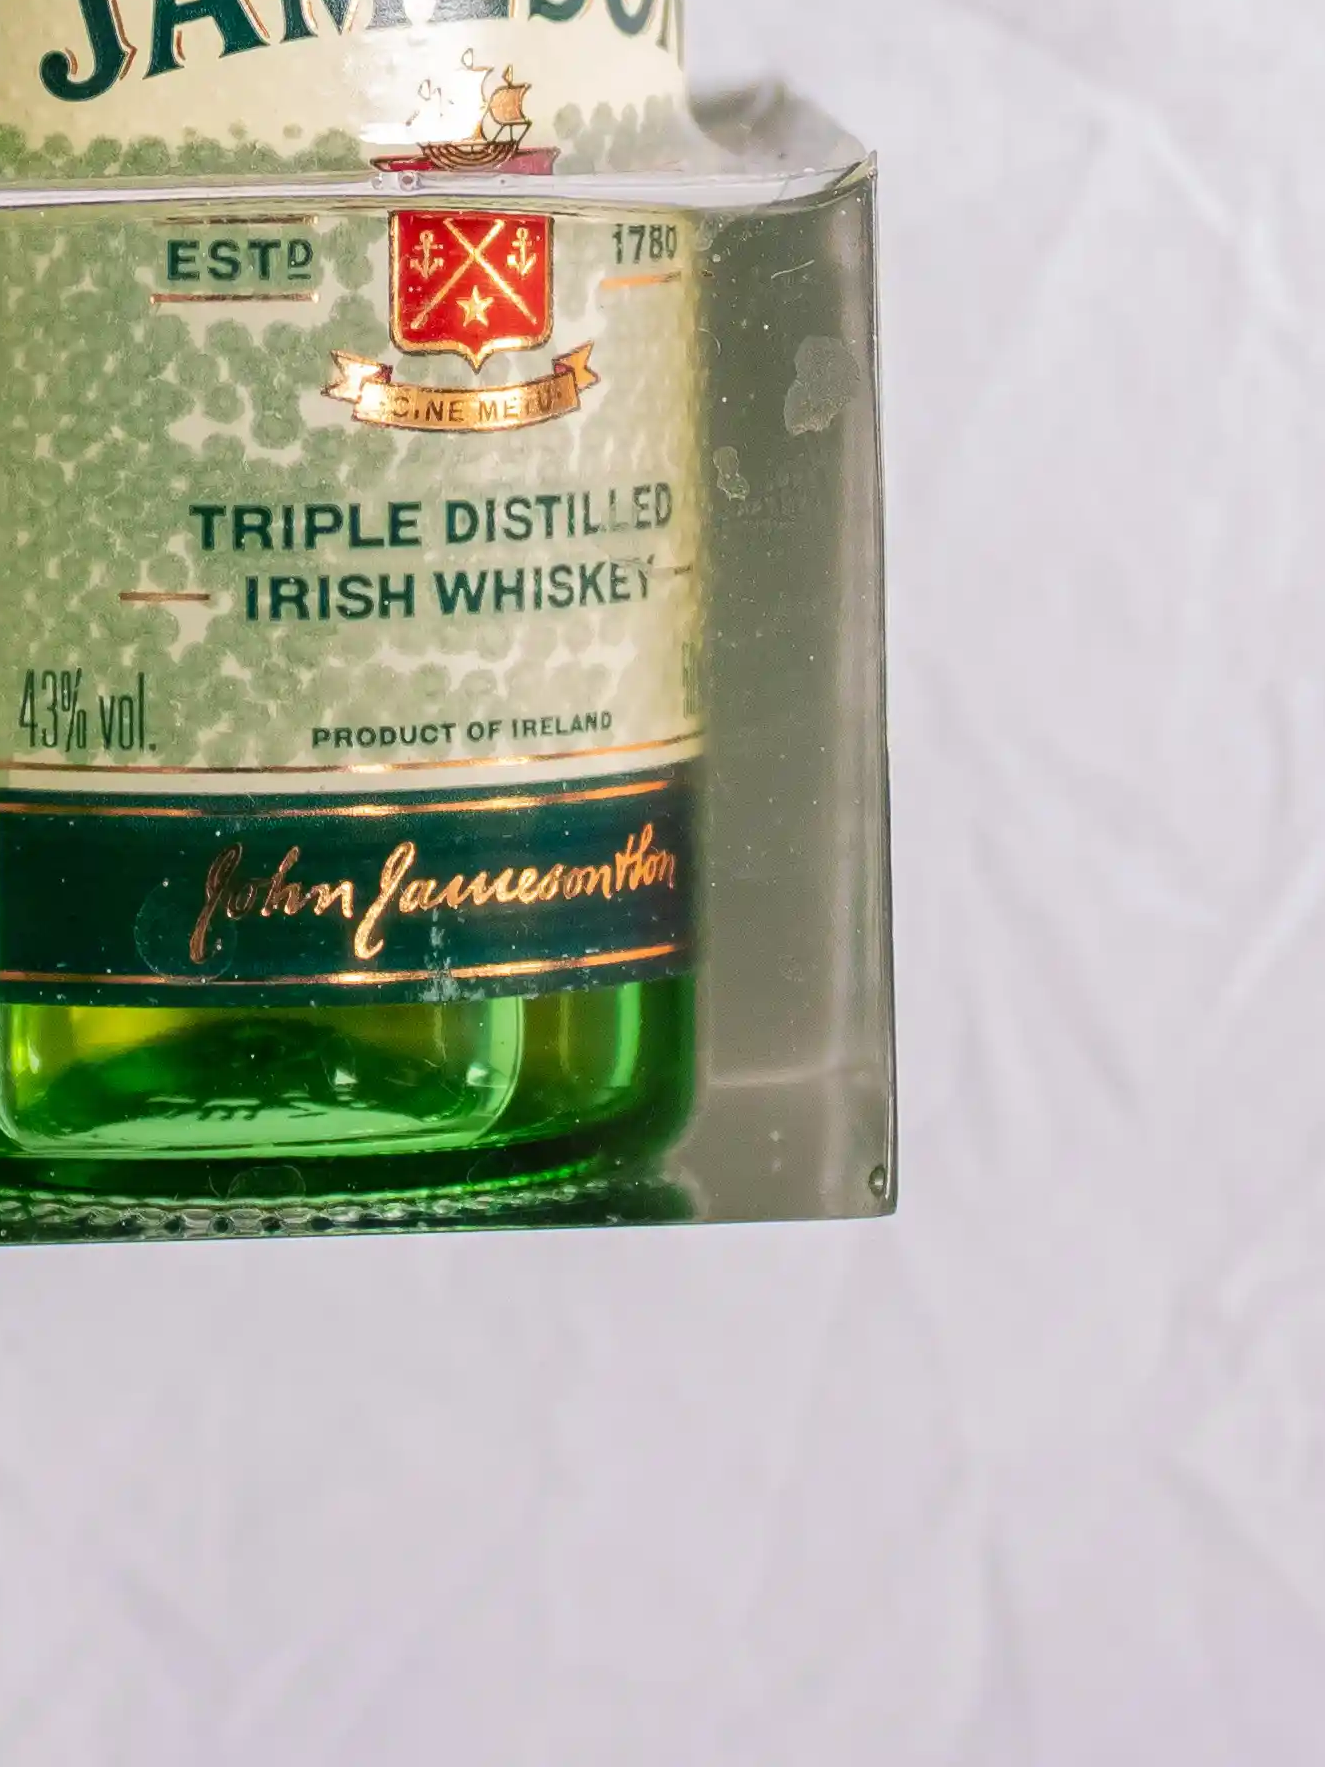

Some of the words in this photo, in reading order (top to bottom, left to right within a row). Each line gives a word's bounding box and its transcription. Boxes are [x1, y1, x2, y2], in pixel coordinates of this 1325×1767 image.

[612, 223, 678, 265] 1780
[189, 501, 422, 551] TRIPLE
[445, 482, 673, 545] DISTILLED
[246, 573, 416, 622] IRISH
[432, 553, 655, 616] WHISKEY
[18, 667, 87, 752] 43%
[98, 672, 157, 752] vol.
[312, 722, 457, 749] PRODUCT
[466, 719, 503, 743] OF
[512, 710, 613, 739] IRELAND
[189, 841, 355, 964] John
[354, 840, 613, 960] Jameson
